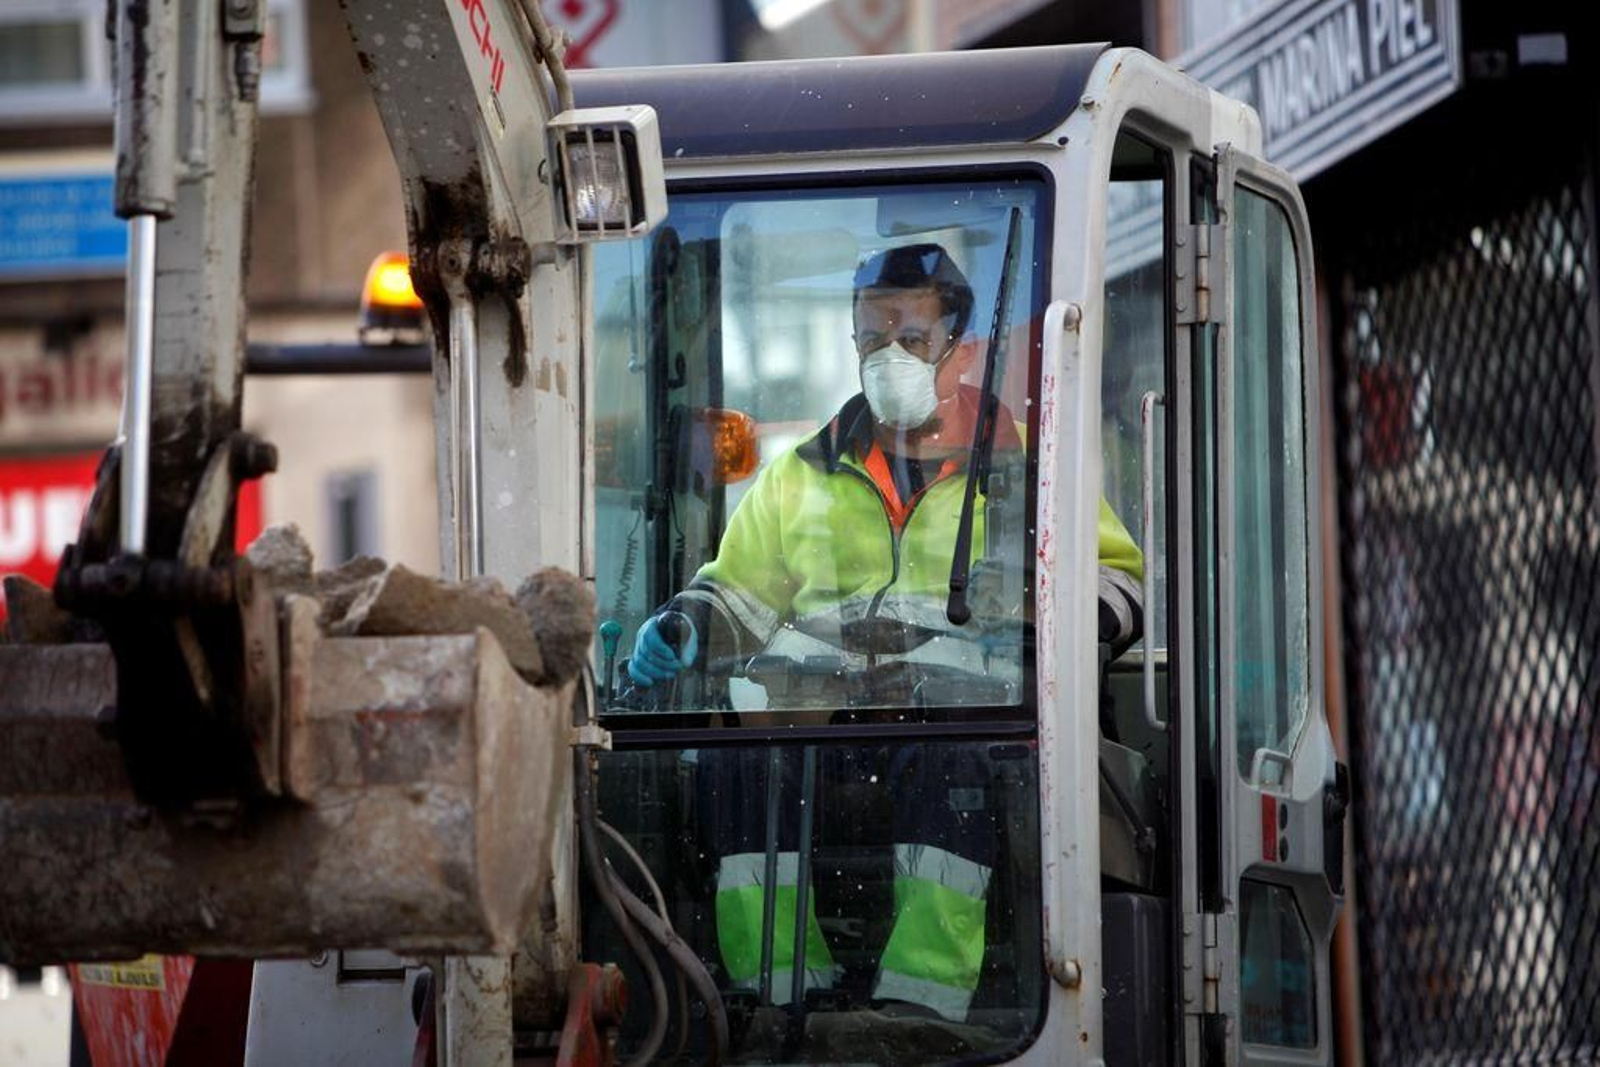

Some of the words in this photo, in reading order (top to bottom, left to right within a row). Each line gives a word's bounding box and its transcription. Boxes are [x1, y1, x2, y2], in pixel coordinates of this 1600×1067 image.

[461, 0, 505, 94] CHI
[1257, 2, 1365, 143] MARINA
[1367, 0, 1433, 79] PIEL
